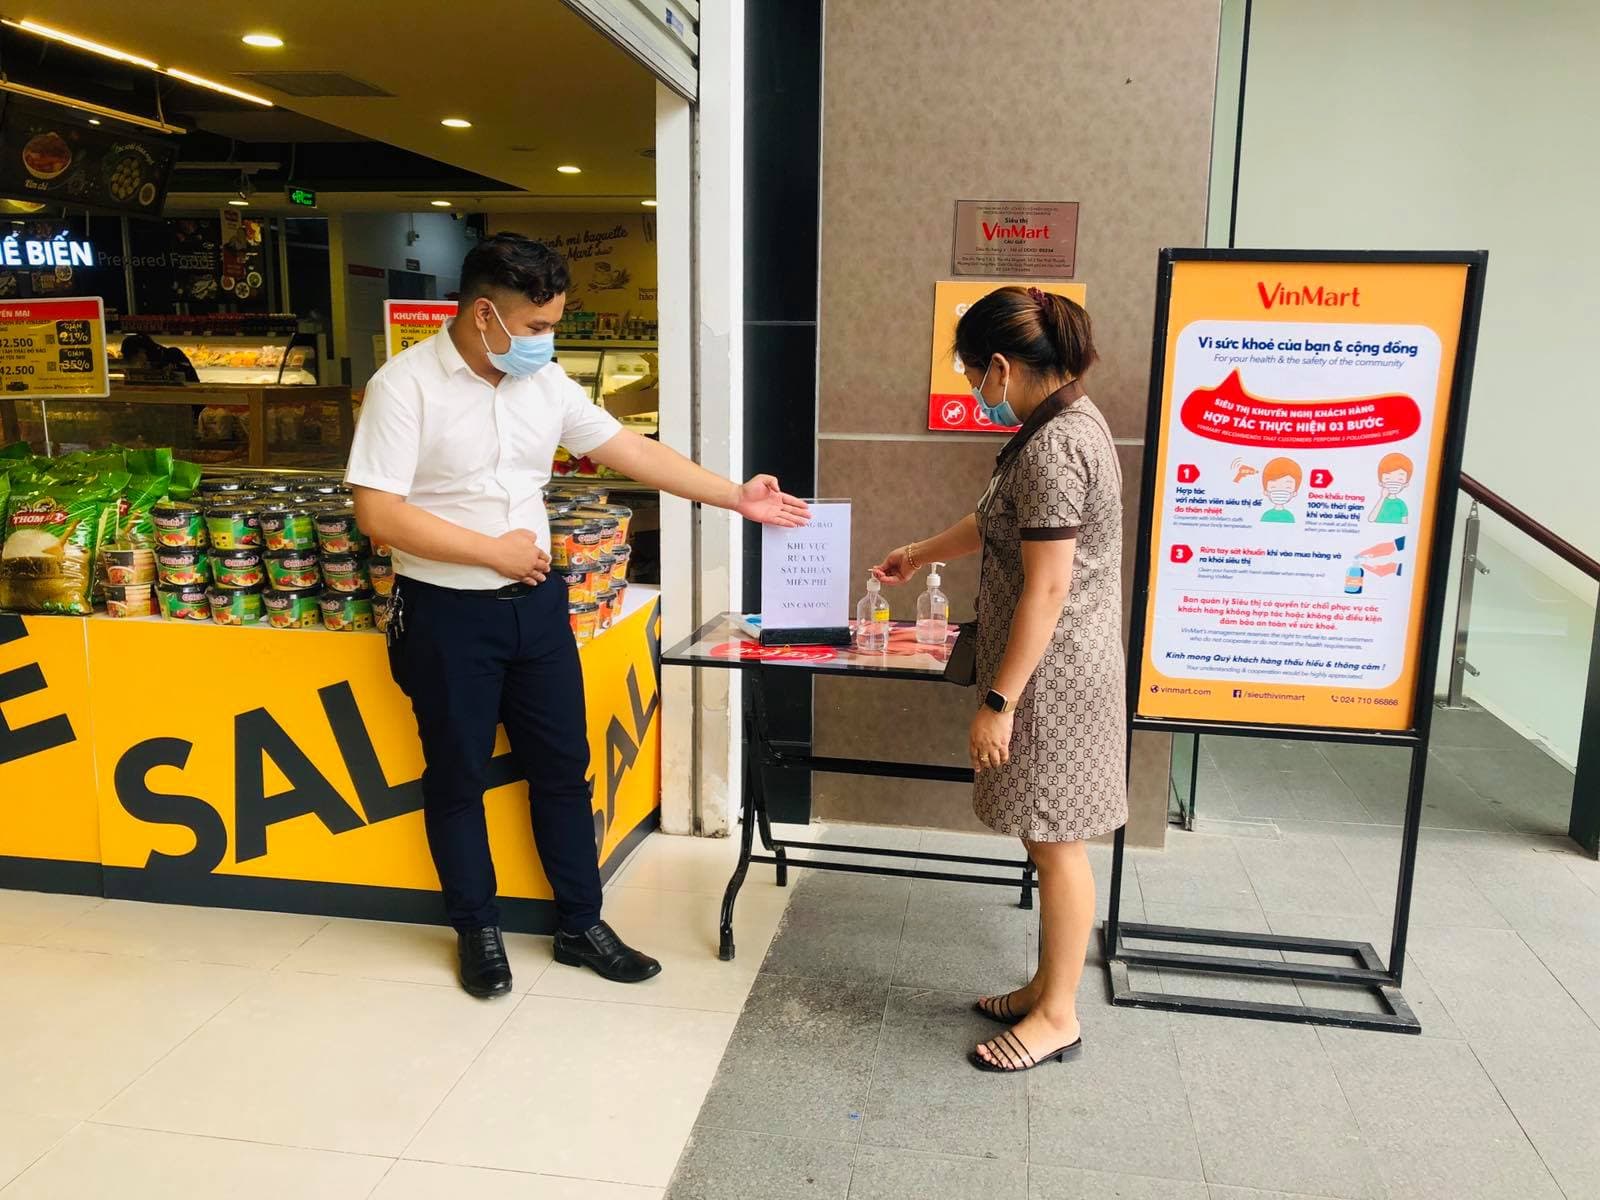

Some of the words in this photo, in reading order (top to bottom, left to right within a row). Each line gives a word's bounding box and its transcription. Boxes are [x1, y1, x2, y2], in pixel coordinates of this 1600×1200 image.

[584, 224, 628, 248] baguette
[983, 222, 1049, 240] VinMart
[0, 231, 21, 265] Ế
[25, 230, 93, 266] BIẾN
[1257, 281, 1360, 309] VinMart
[393, 311, 430, 320] KHUYẾN
[1198, 336, 1212, 348] Vì
[1215, 337, 1239, 349] sức
[1242, 337, 1274, 350] khoẻ
[1277, 338, 1301, 351] của
[1305, 339, 1330, 355] bạn
[1333, 340, 1343, 352] &
[1346, 340, 1379, 356] cộng
[1383, 340, 1418, 357] đồng
[62, 360, 90, 370] 35%
[1214, 354, 1227, 362] For
[1228, 356, 1247, 365] your
[1249, 354, 1276, 363] health
[1277, 355, 1284, 364] &
[1286, 355, 1300, 364] the
[1301, 357, 1327, 367] safety
[1329, 357, 1338, 366] of
[1339, 358, 1353, 366] the
[1355, 359, 1405, 369] community
[1214, 398, 1234, 410] SIÊU
[1236, 404, 1250, 415] THỊ
[1251, 407, 1287, 417] KHUYẾN
[1290, 410, 1312, 419] NGHỊ
[1314, 408, 1346, 417] KHÁCH
[1348, 404, 1375, 415] HÀNG
[1202, 410, 1230, 426] HỢP
[1233, 416, 1256, 429] TÁC
[1259, 420, 1293, 434] THỰC
[1296, 420, 1326, 434] HIỆN
[1329, 422, 1344, 432] 03
[1346, 416, 1384, 430] BƯỚC
[1183, 468, 1190, 479] 1
[1314, 473, 1324, 484] 2
[1331, 502, 1346, 510] thời
[1348, 503, 1364, 511] gian
[1175, 548, 1184, 559] 3
[1200, 597, 1220, 605] quản
[1222, 597, 1229, 605] lý
[1231, 598, 1248, 606] Siêu
[1250, 599, 1261, 608] thị
[1274, 600, 1298, 609] quyền
[1312, 601, 1329, 609] chối
[1331, 603, 1351, 613] phục
[1353, 605, 1363, 613] vụ
[1364, 604, 1379, 612] các
[1178, 605, 1202, 613] khách
[1204, 606, 1224, 615] hàng
[1226, 607, 1250, 616] không
[1253, 609, 1269, 618] hợp
[1271, 609, 1283, 617] tác
[1285, 611, 1304, 619] hoặc
[1307, 612, 1332, 621] không
[1345, 613, 1363, 621] điều
[1365, 614, 1382, 623] kiện
[1219, 617, 1237, 625] đảm
[1239, 618, 1254, 626] bảo
[1268, 619, 1286, 627] toàn
[1300, 621, 1313, 629] sức
[1165, 651, 1185, 659] Kính
[1186, 653, 1211, 662] mong
[1213, 653, 1231, 663] Quý
[1232, 655, 1259, 664] khách
[1260, 657, 1282, 666] hàng
[1284, 658, 1303, 666] thấu
[1305, 659, 1324, 668] hiểu
[1325, 660, 1332, 668] &
[1334, 660, 1360, 671] thông
[1361, 662, 1380, 670] cảm
[1160, 686, 1211, 695] vinmart.com
[1243, 690, 1305, 701] /sieuthivinmart
[1340, 696, 1355, 704] 024
[113, 680, 527, 873] SAL
